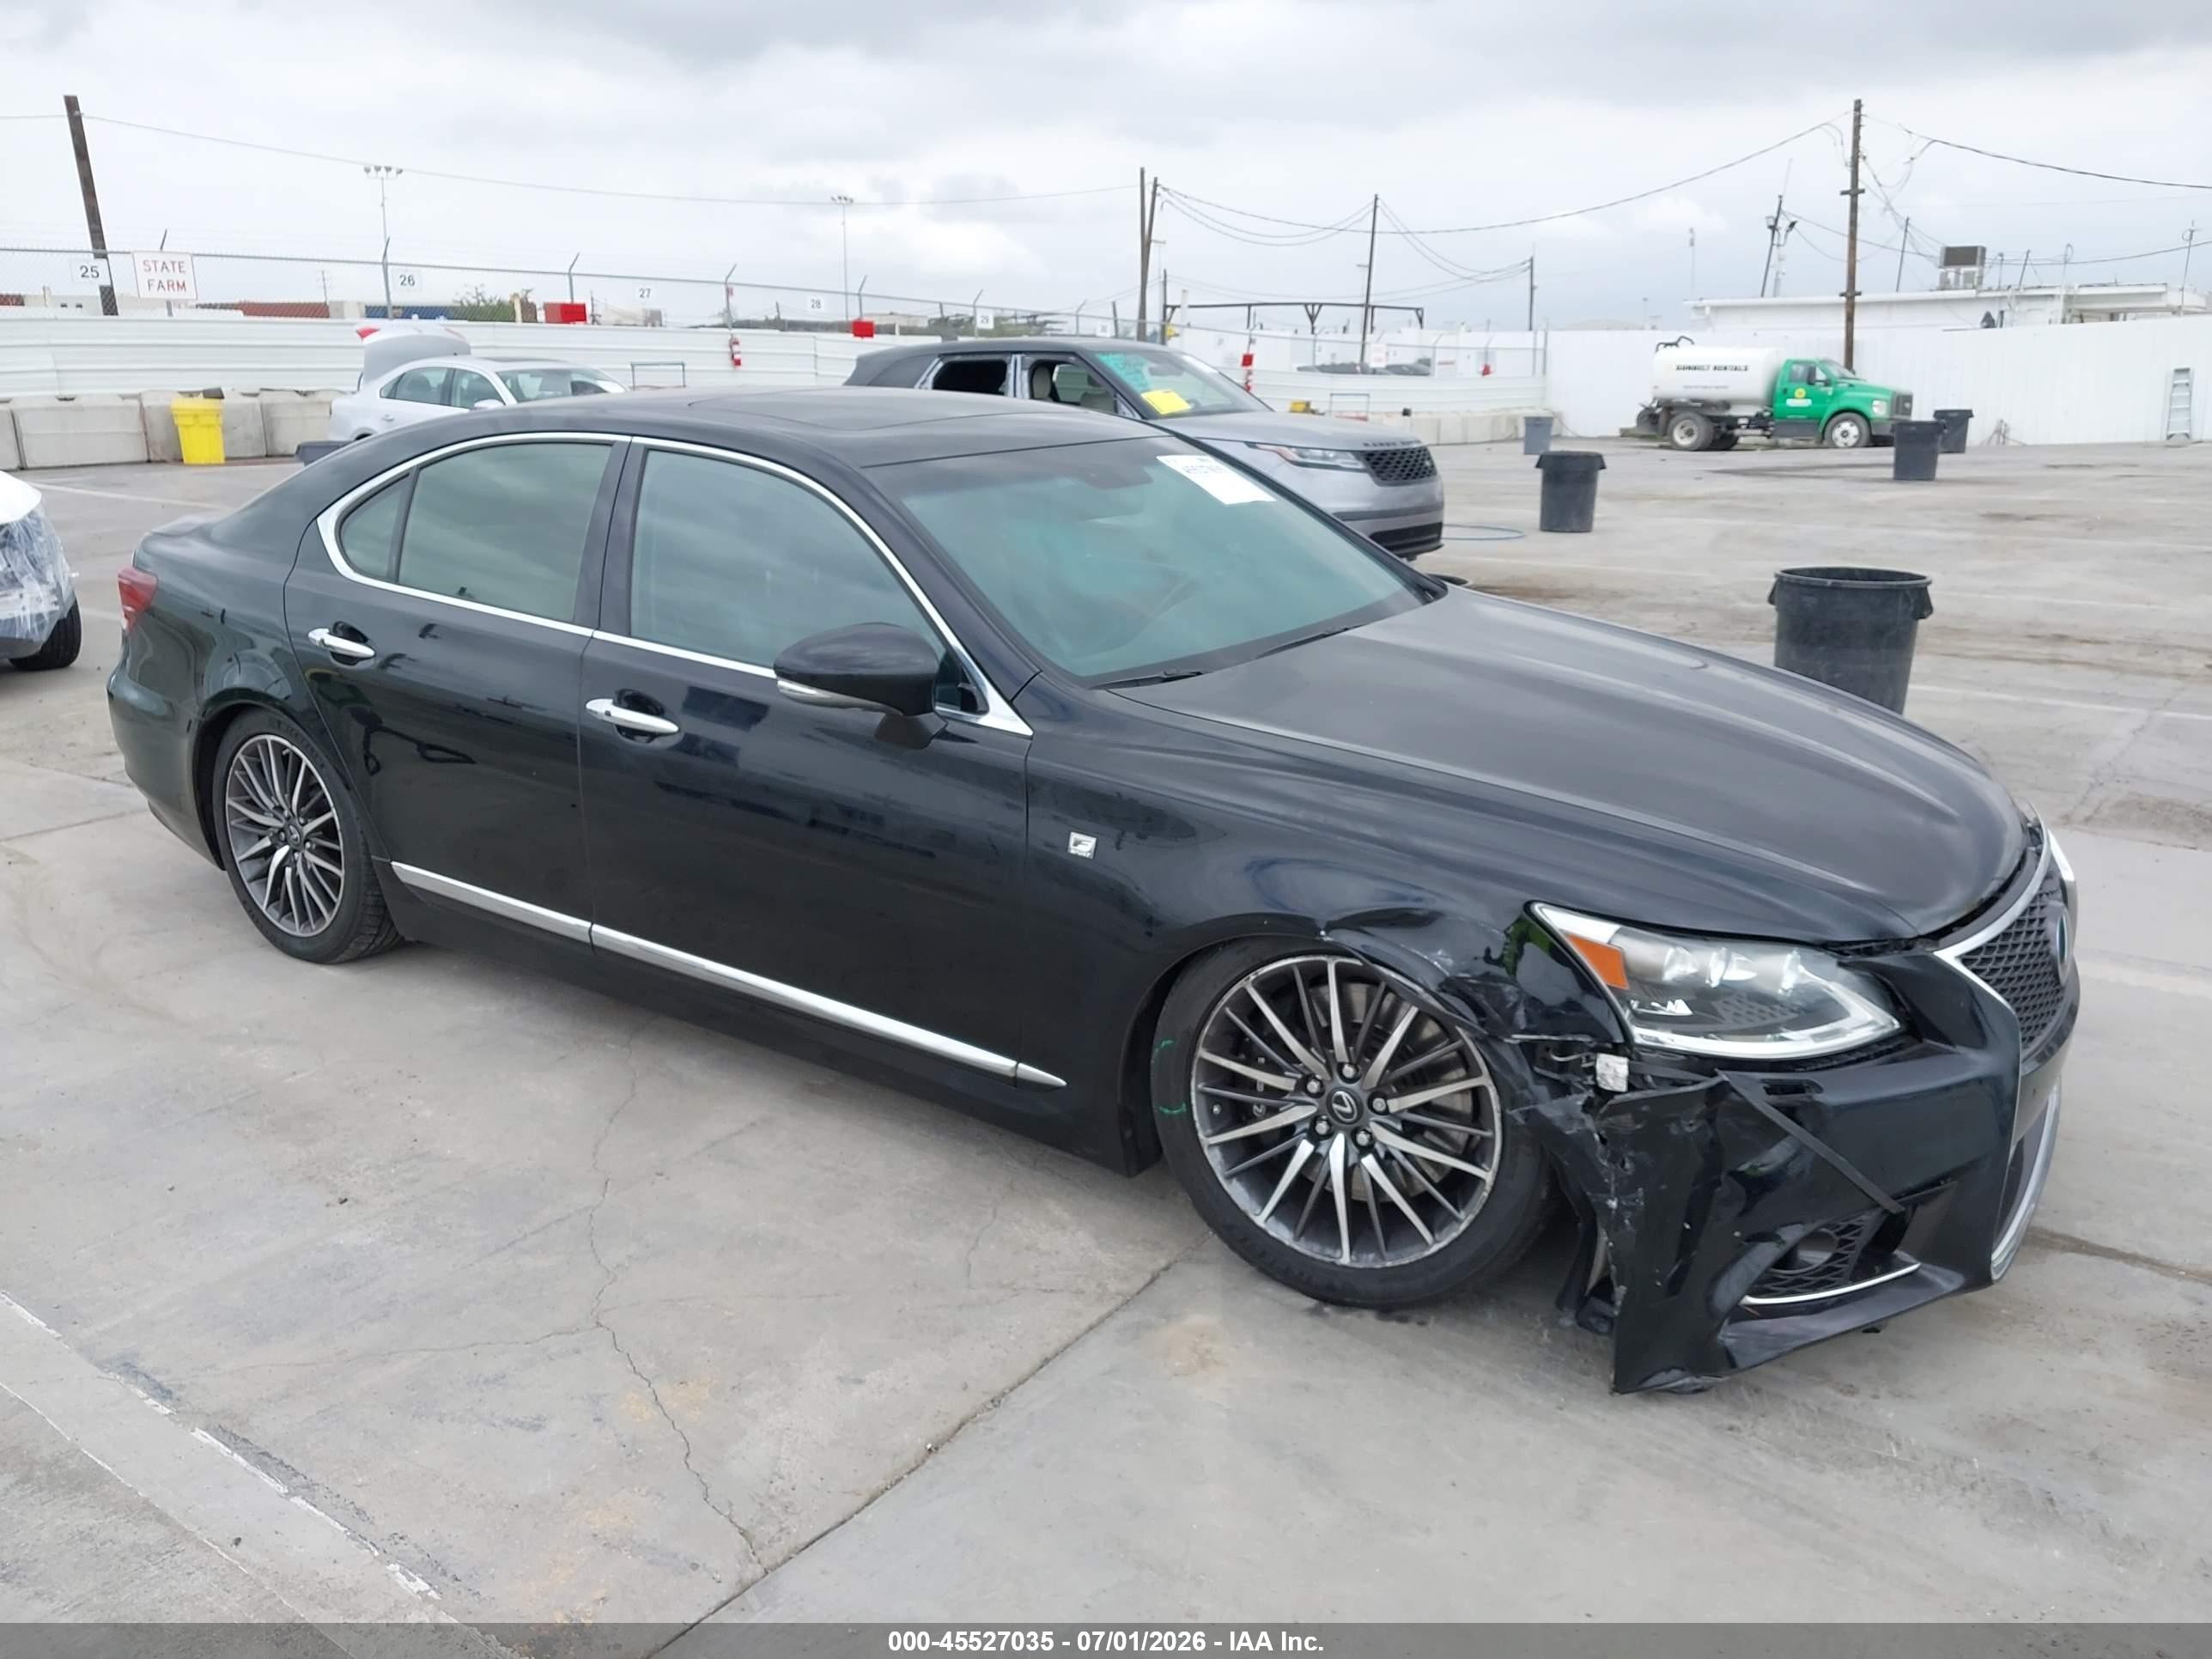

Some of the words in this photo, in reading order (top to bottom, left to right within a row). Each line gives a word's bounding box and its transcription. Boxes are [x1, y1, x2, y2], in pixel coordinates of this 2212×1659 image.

[79, 264, 100, 279] 25
[143, 259, 186, 274] STATE
[147, 278, 187, 293] FARM
[398, 274, 416, 287] 26
[638, 288, 651, 299] 27
